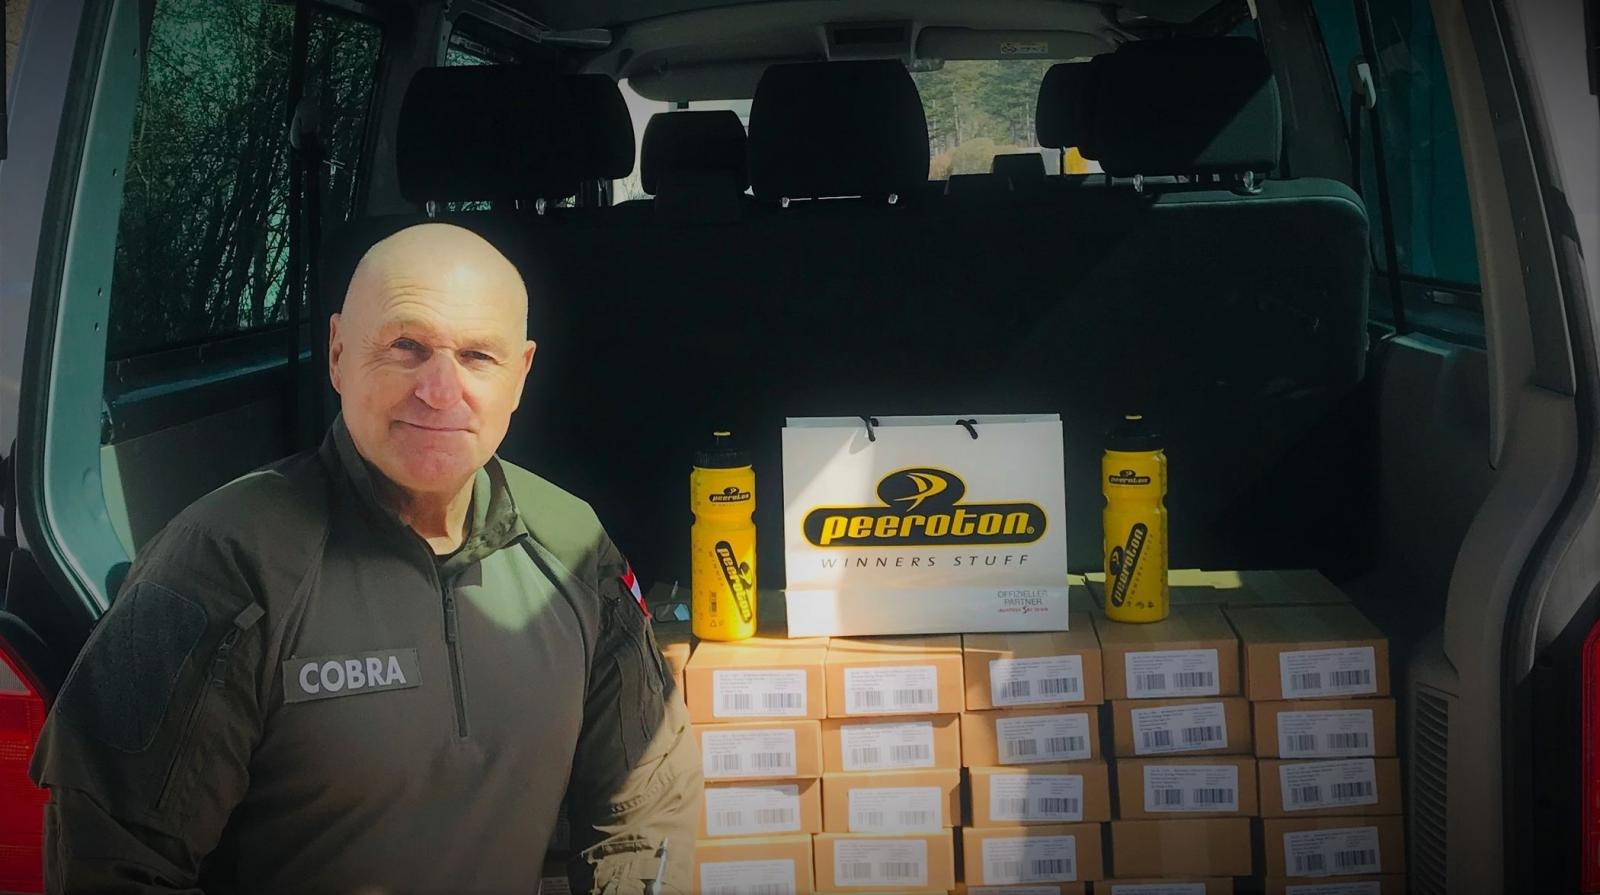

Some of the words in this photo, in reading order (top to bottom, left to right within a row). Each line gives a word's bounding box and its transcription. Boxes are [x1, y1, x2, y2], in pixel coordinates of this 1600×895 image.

[819, 509, 1029, 545] peeroton
[821, 556, 936, 569] WINNERS
[953, 554, 1029, 567] STUFF
[1113, 528, 1144, 603] peeroton
[299, 655, 407, 694] COBRA
